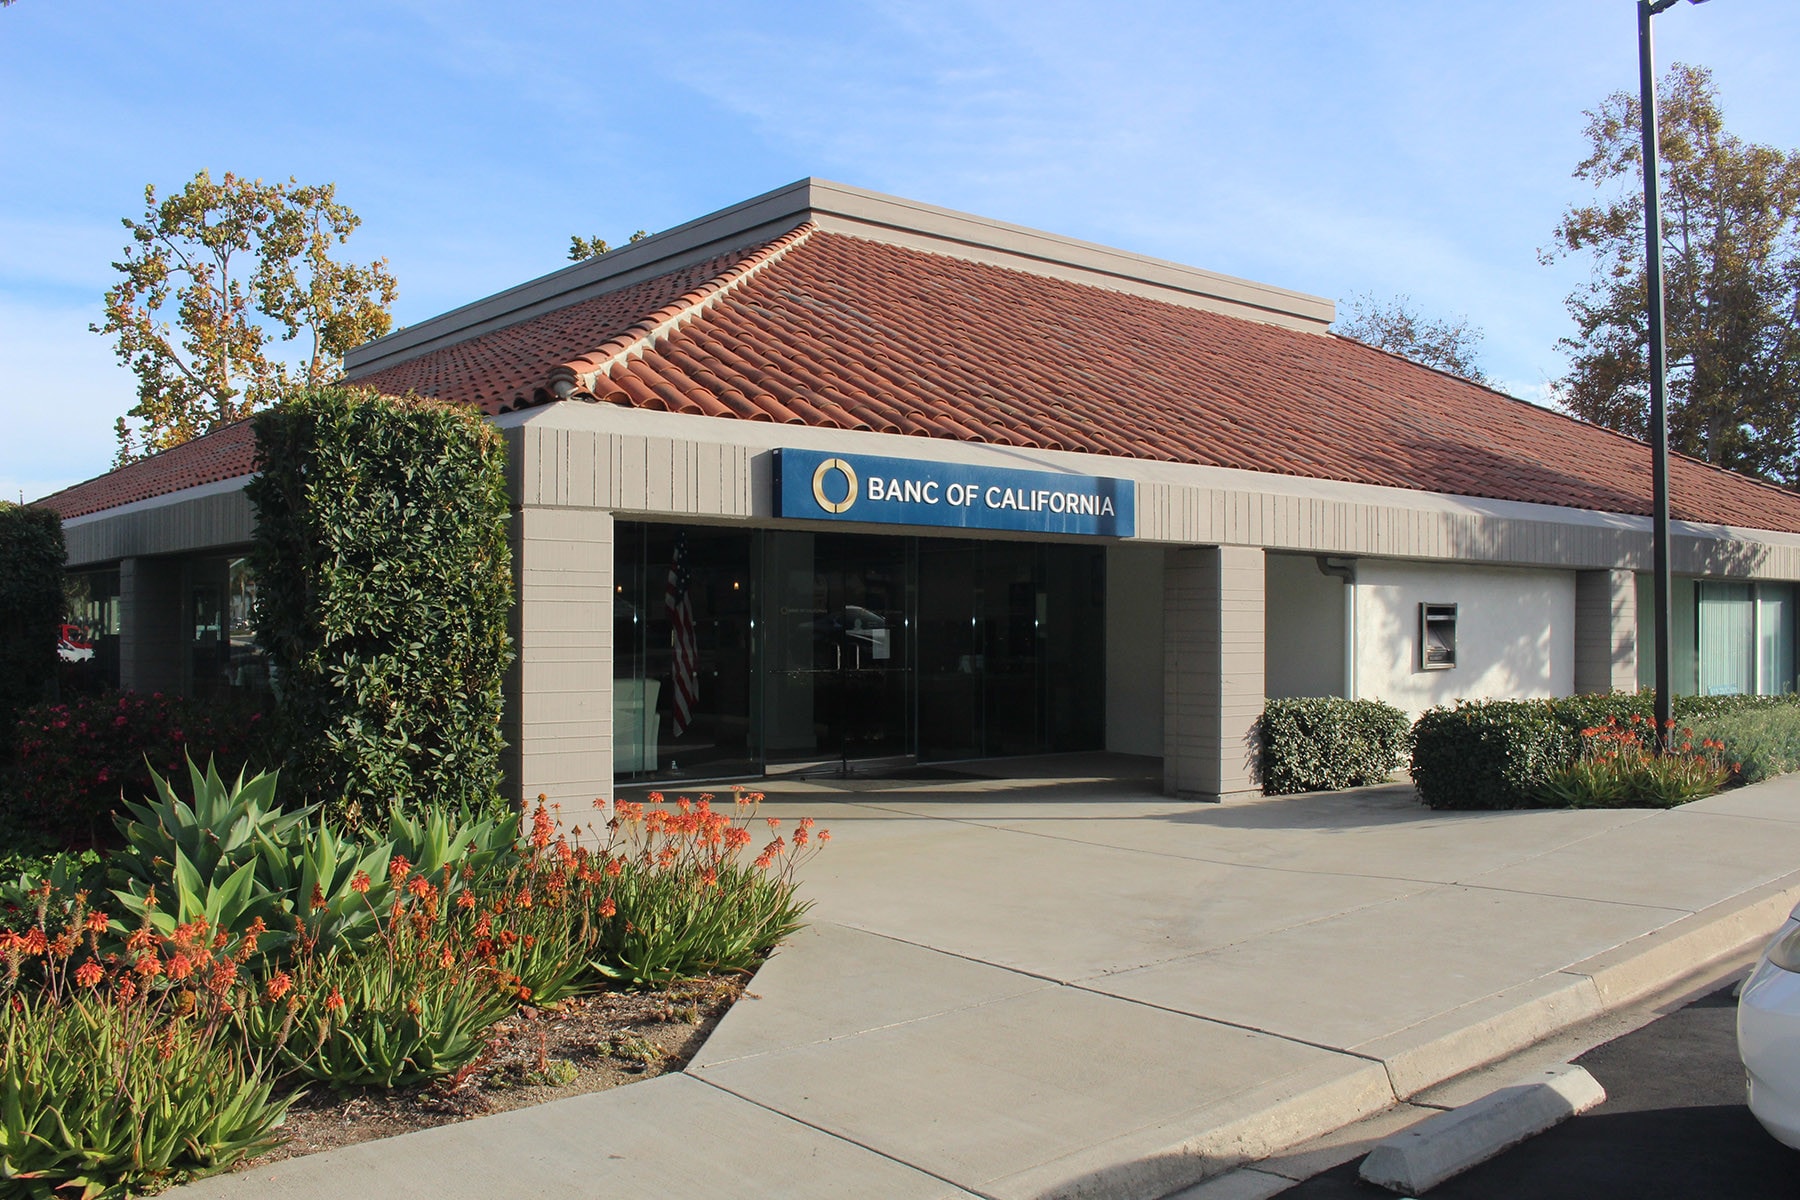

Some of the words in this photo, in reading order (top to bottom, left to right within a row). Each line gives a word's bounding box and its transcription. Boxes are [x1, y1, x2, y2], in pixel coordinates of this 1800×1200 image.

[868, 476, 939, 505] BANC
[946, 483, 979, 507] OF
[985, 487, 1115, 518] CALIFORNIA
